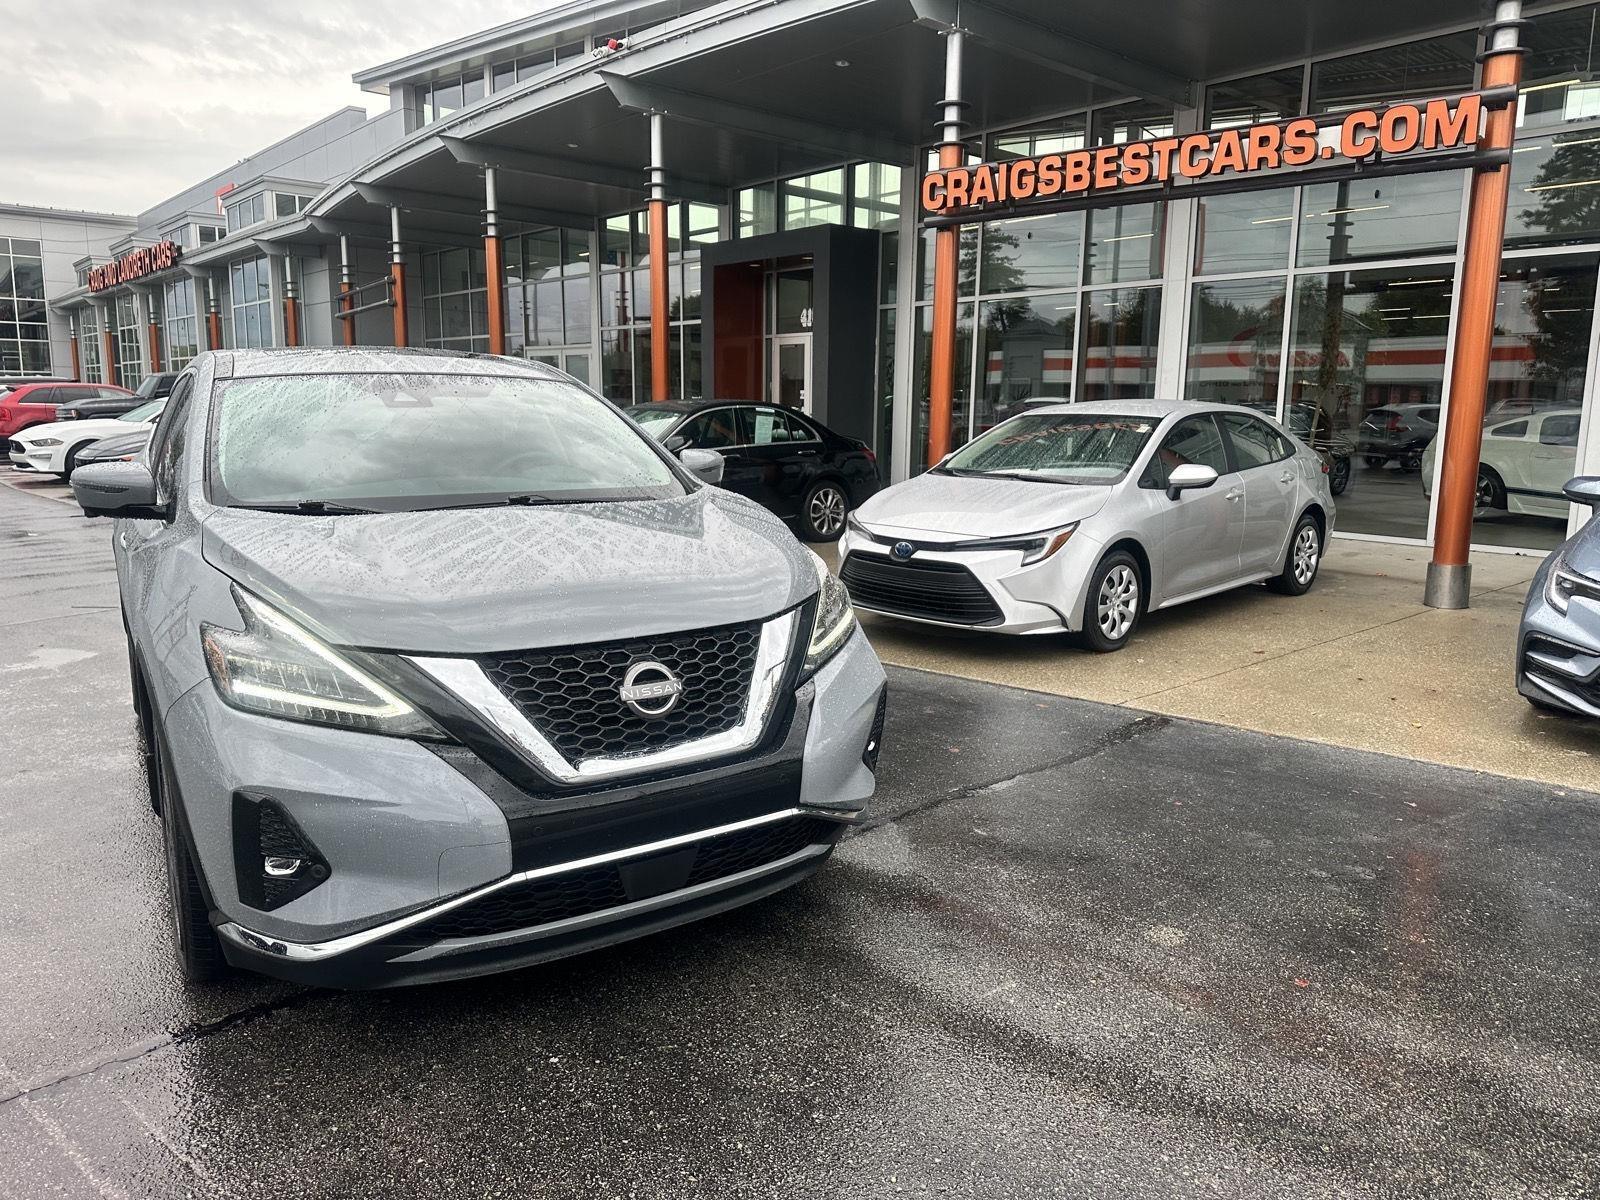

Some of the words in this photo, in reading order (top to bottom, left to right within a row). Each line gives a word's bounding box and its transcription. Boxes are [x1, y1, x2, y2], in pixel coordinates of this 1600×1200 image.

[922, 95, 1482, 211] CRAIGSBESTCARS.COM
[104, 263, 117, 286] AND
[118, 249, 151, 281] LANDRETH
[151, 240, 173, 271] CARS
[621, 681, 682, 699] NISSAN
